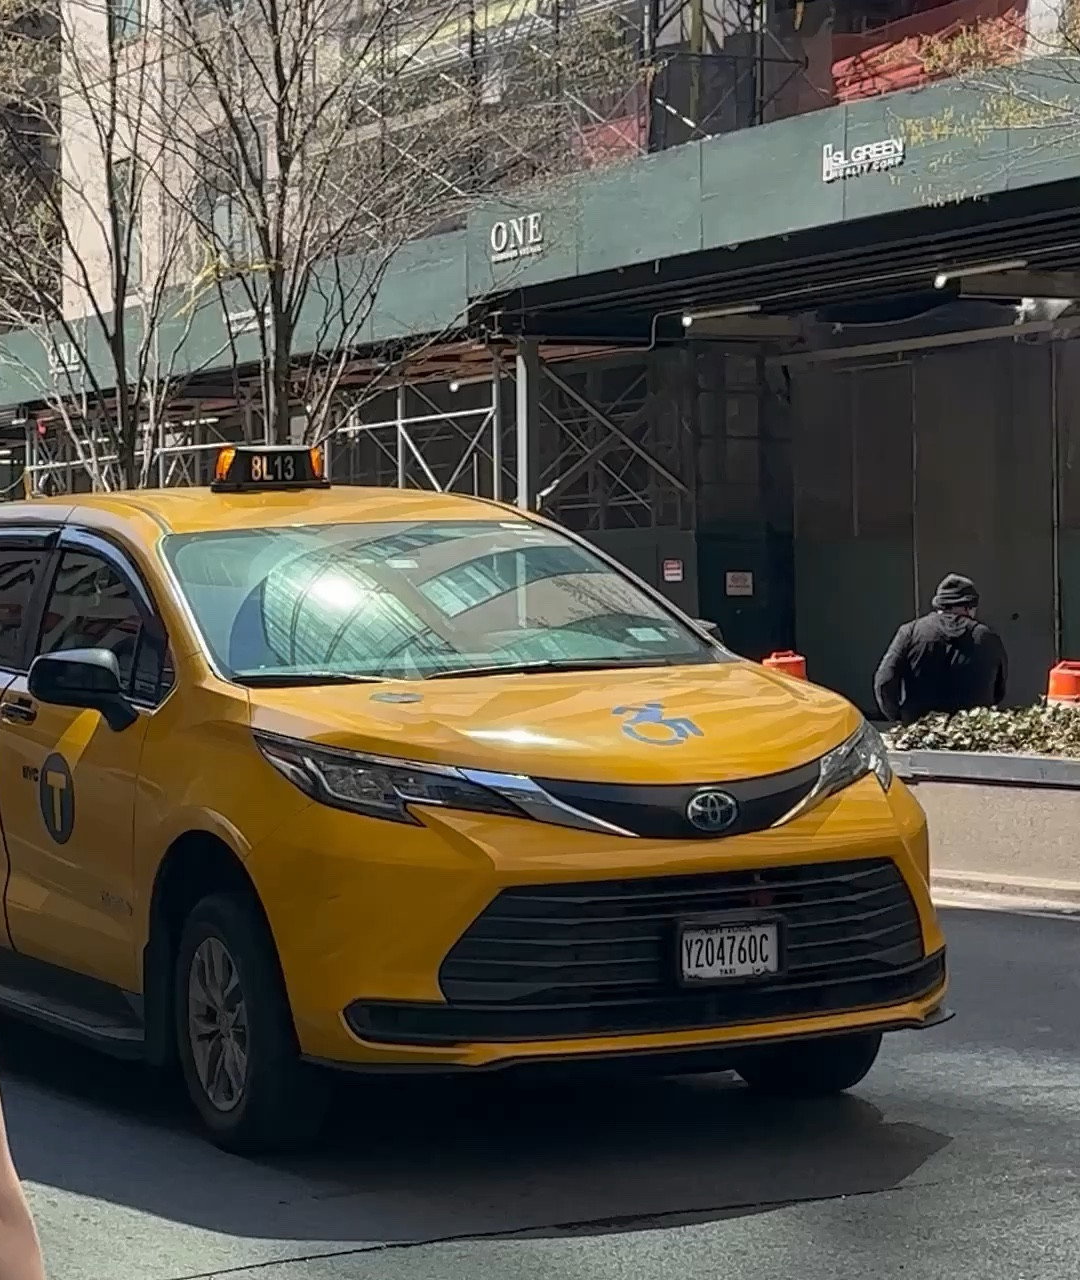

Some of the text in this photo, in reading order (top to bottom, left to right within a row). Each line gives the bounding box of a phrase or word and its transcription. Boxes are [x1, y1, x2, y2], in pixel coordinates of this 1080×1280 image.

[851, 137, 904, 162] GREEN
[490, 212, 543, 252] ONE
[251, 455, 295, 481] 8L13
[685, 933, 769, 969] Y204760C
